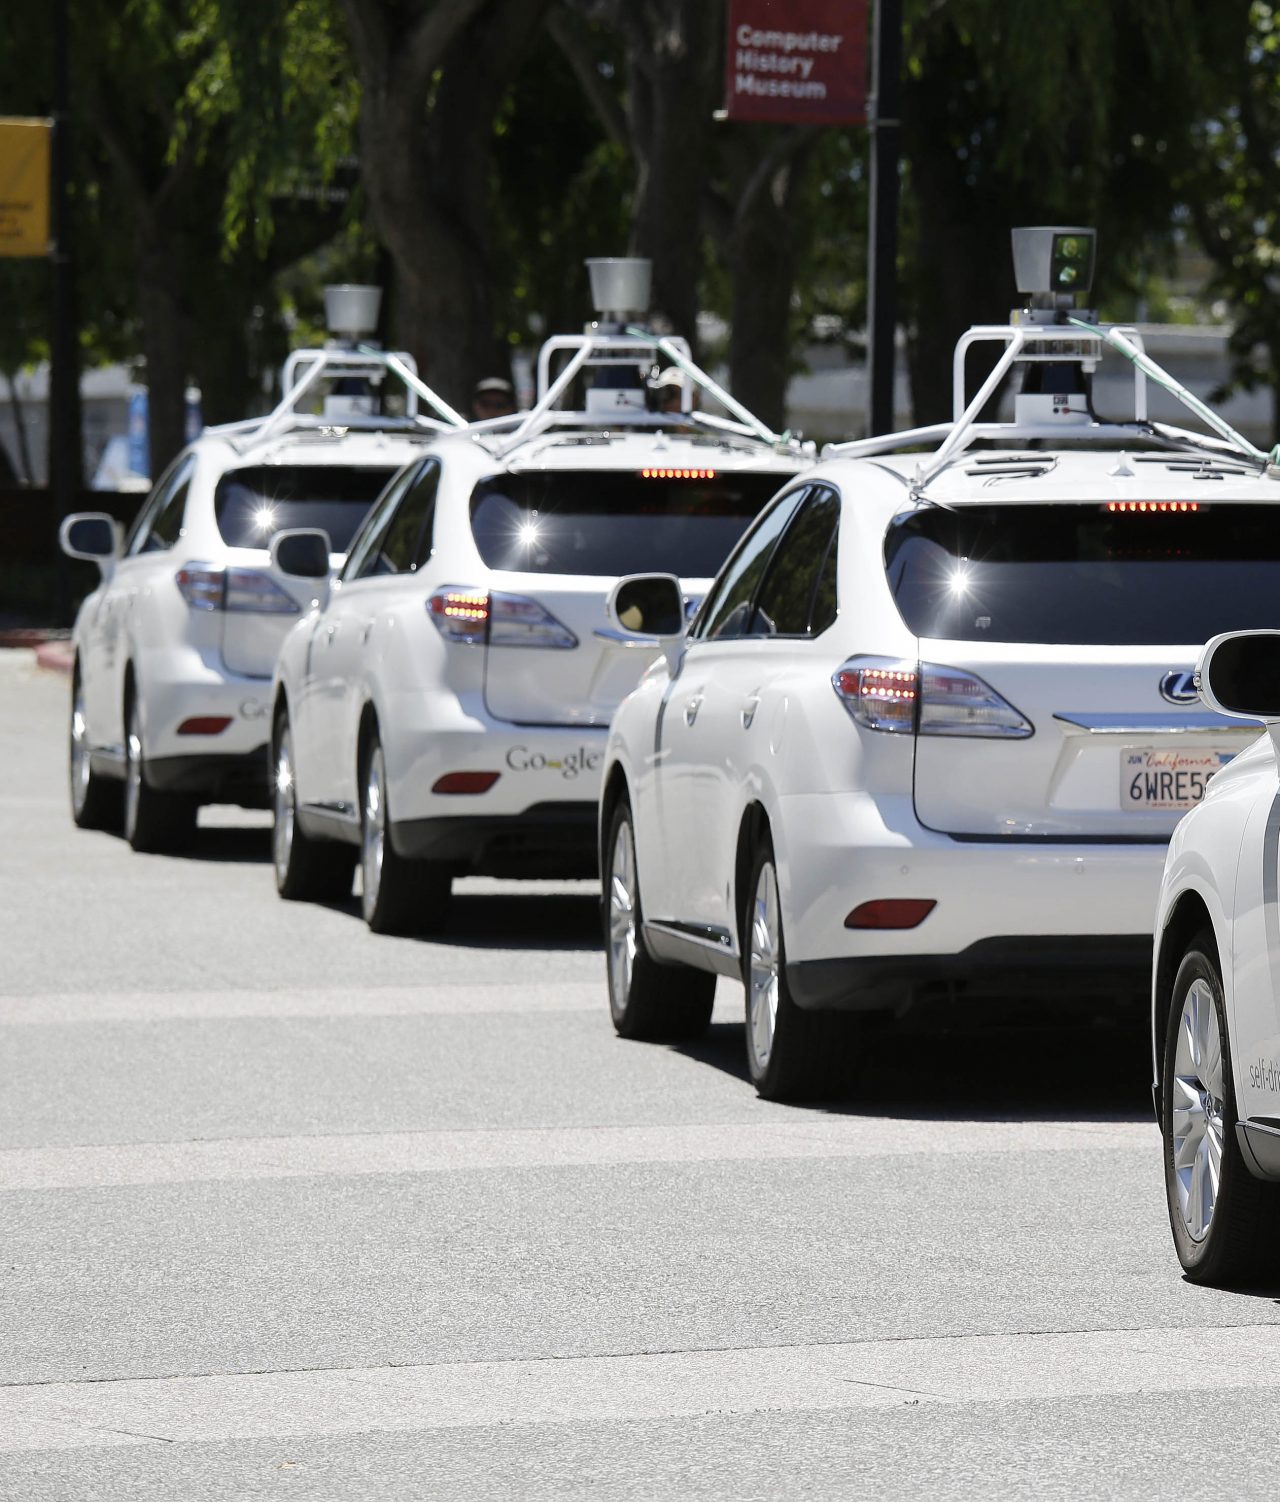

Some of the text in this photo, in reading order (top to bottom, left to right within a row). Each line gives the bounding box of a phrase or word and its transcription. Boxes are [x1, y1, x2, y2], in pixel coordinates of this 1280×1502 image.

[736, 24, 843, 52] Computer
[735, 50, 814, 78] History
[735, 73, 827, 98] Museum
[1146, 752, 1219, 771] California
